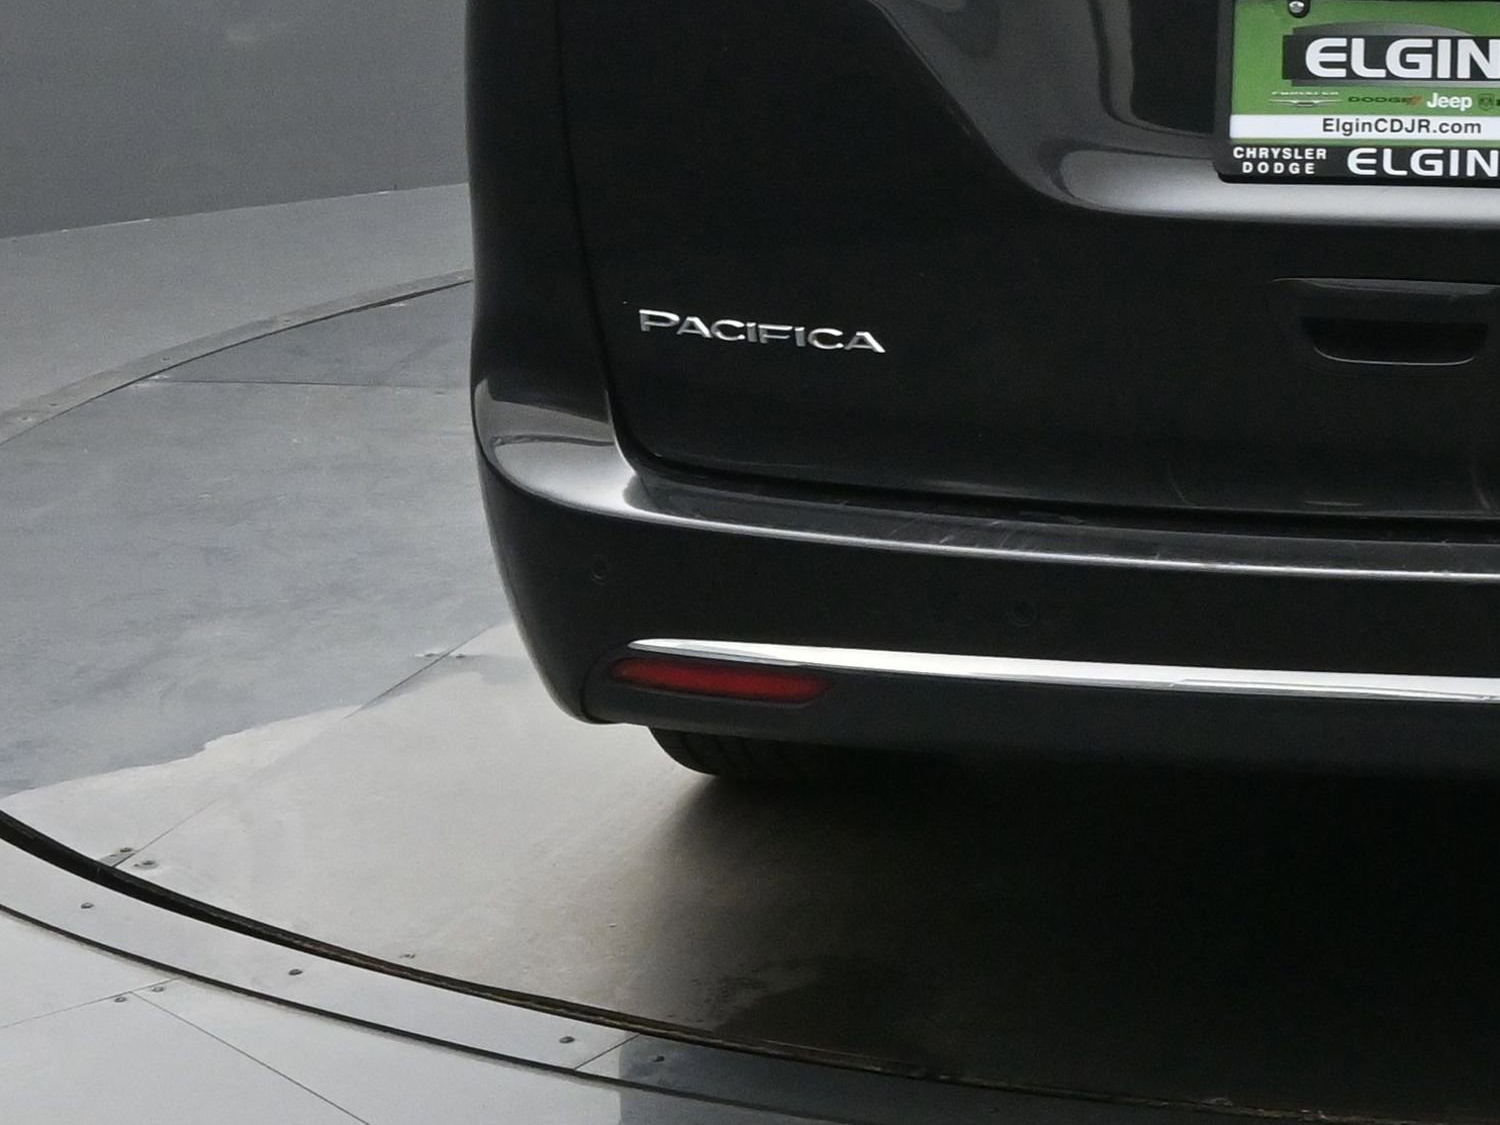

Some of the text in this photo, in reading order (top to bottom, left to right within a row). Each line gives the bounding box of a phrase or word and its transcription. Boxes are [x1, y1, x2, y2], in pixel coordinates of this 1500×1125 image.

[1426, 92, 1473, 111] Jeep
[1322, 118, 1482, 136] ElginCDJR.com
[1233, 147, 1327, 161] CHRYSLER
[1347, 148, 1499, 178] ELGIN
[1243, 162, 1316, 175] DODGE
[638, 309, 886, 353] PACIFICA
